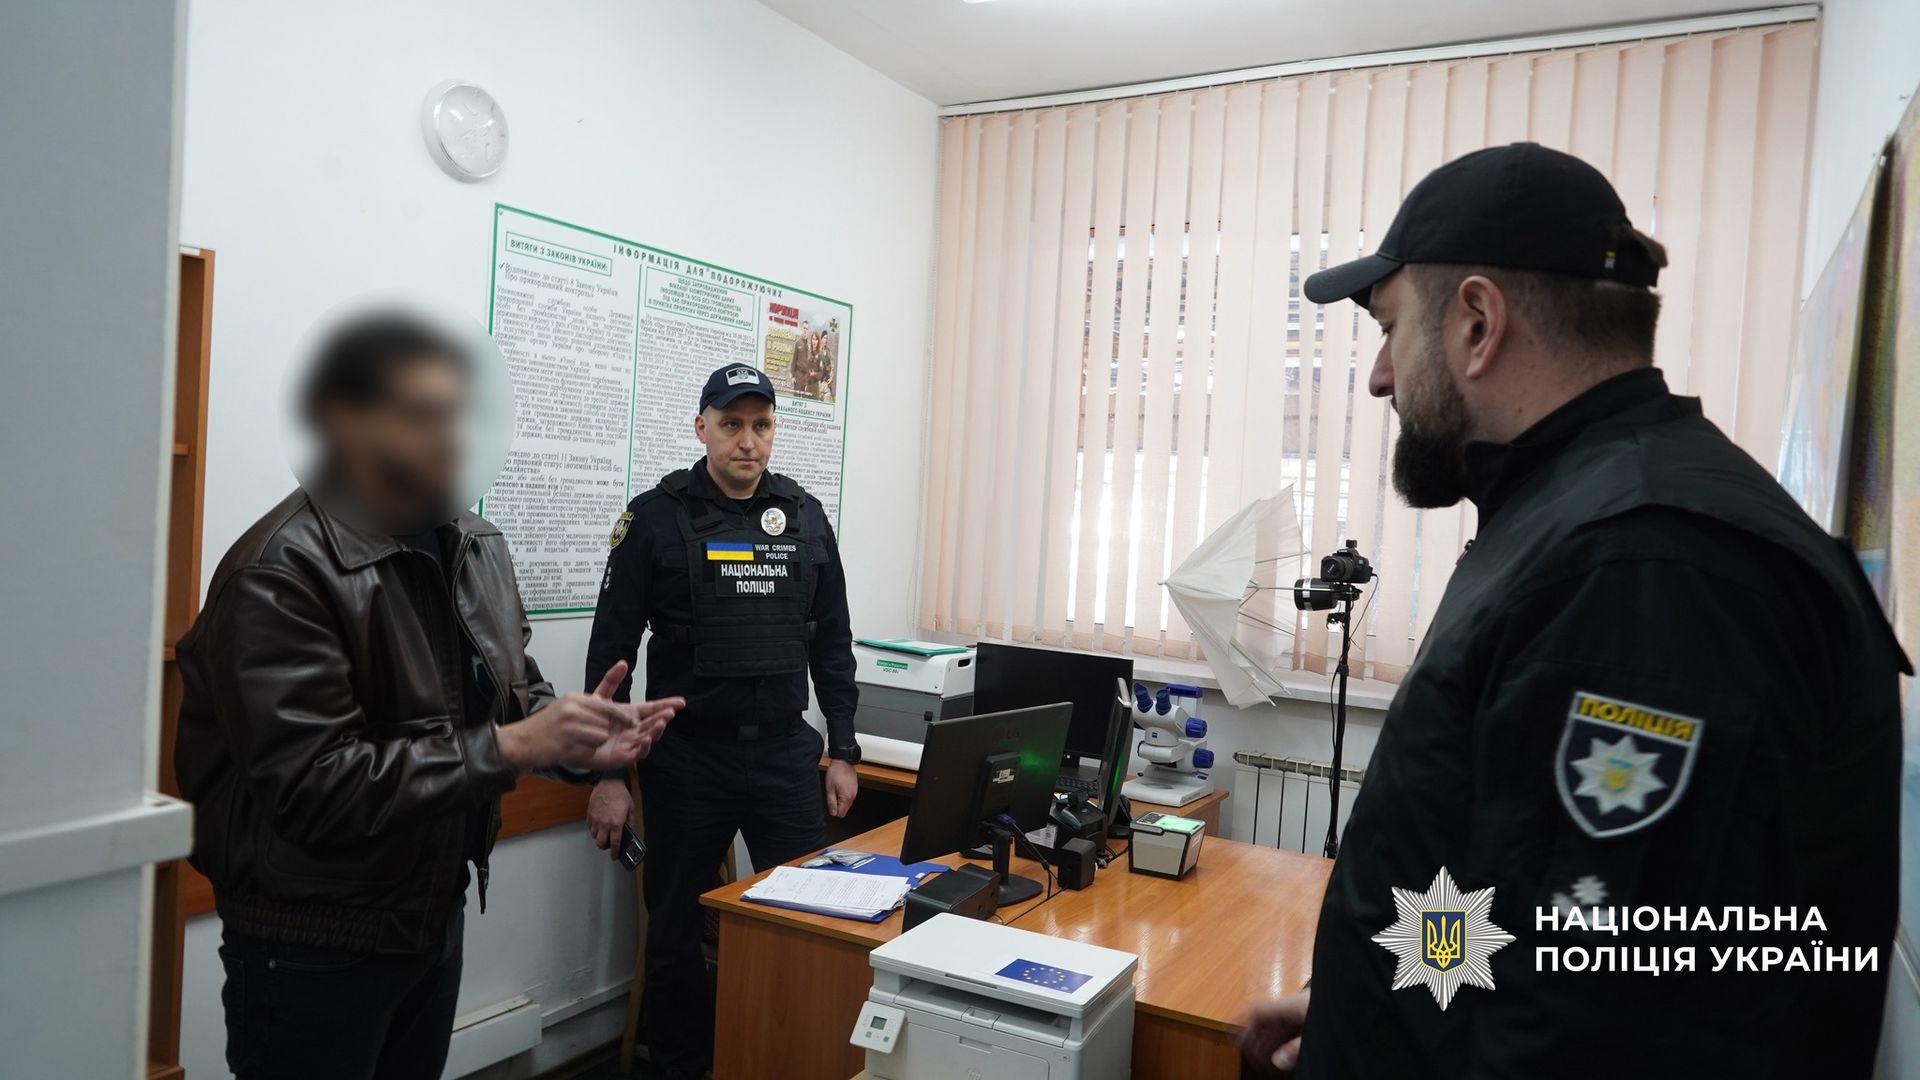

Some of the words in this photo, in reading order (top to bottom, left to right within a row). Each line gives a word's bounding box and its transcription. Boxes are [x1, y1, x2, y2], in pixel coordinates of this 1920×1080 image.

[510, 238, 538, 254] ВИТЯГИ
[540, 246, 544, 256] З
[546, 247, 576, 264] ЗАКОНІВ
[613, 244, 680, 270] ІНФОРМАЦІЯ
[686, 265, 704, 277] ДЛЯ
[710, 271, 783, 298] ПОДОРОЖУЮЧИХ
[754, 544, 770, 552] WAR
[772, 544, 797, 552] CRIMES
[765, 552, 788, 560] POLICE
[721, 563, 788, 579] НАЦІОНАЛЬНА
[736, 580, 775, 596] ПОЛІЦІЯ
[1578, 697, 1695, 742] ПОЛІЦІЯ
